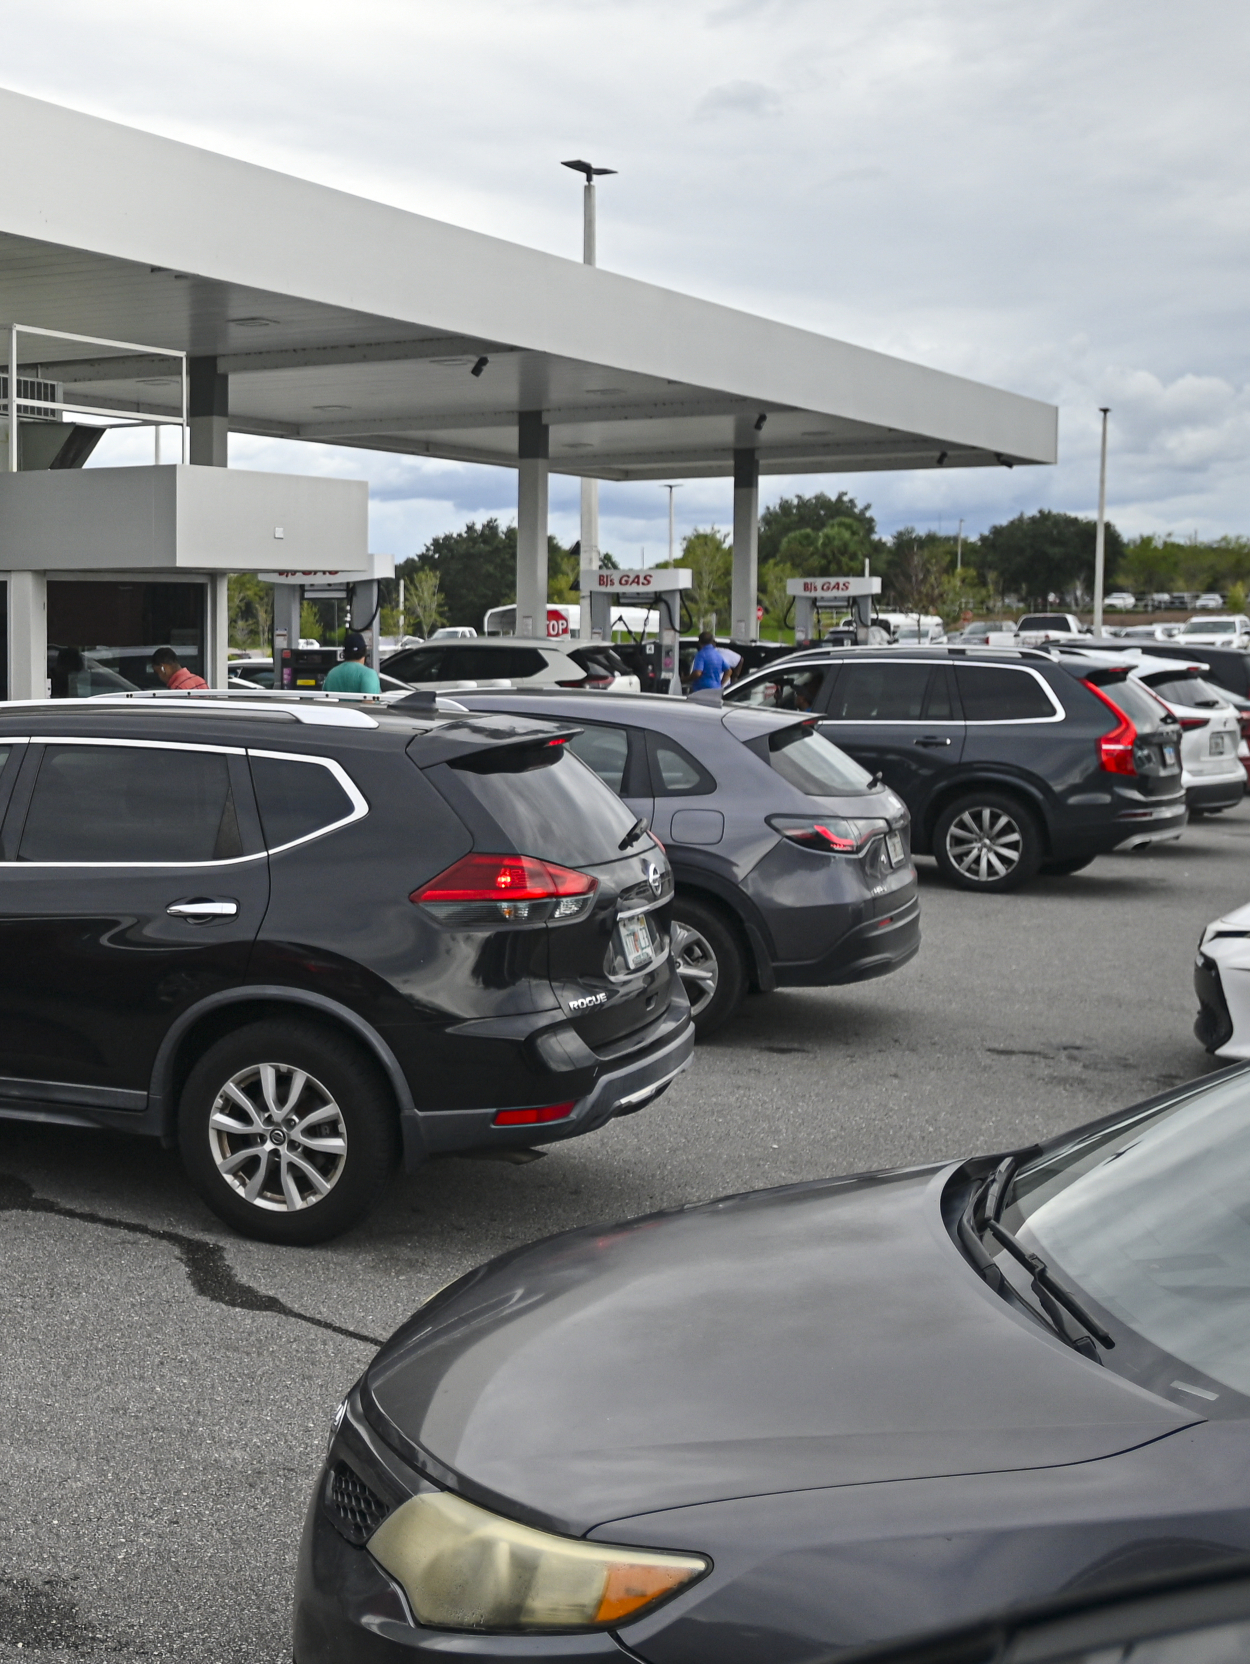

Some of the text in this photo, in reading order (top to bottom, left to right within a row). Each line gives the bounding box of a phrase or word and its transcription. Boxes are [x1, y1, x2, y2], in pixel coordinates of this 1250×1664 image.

[598, 574, 653, 588] BJ's GAS
[821, 581, 851, 591] GAS
[568, 993, 608, 1012] ROGUE
